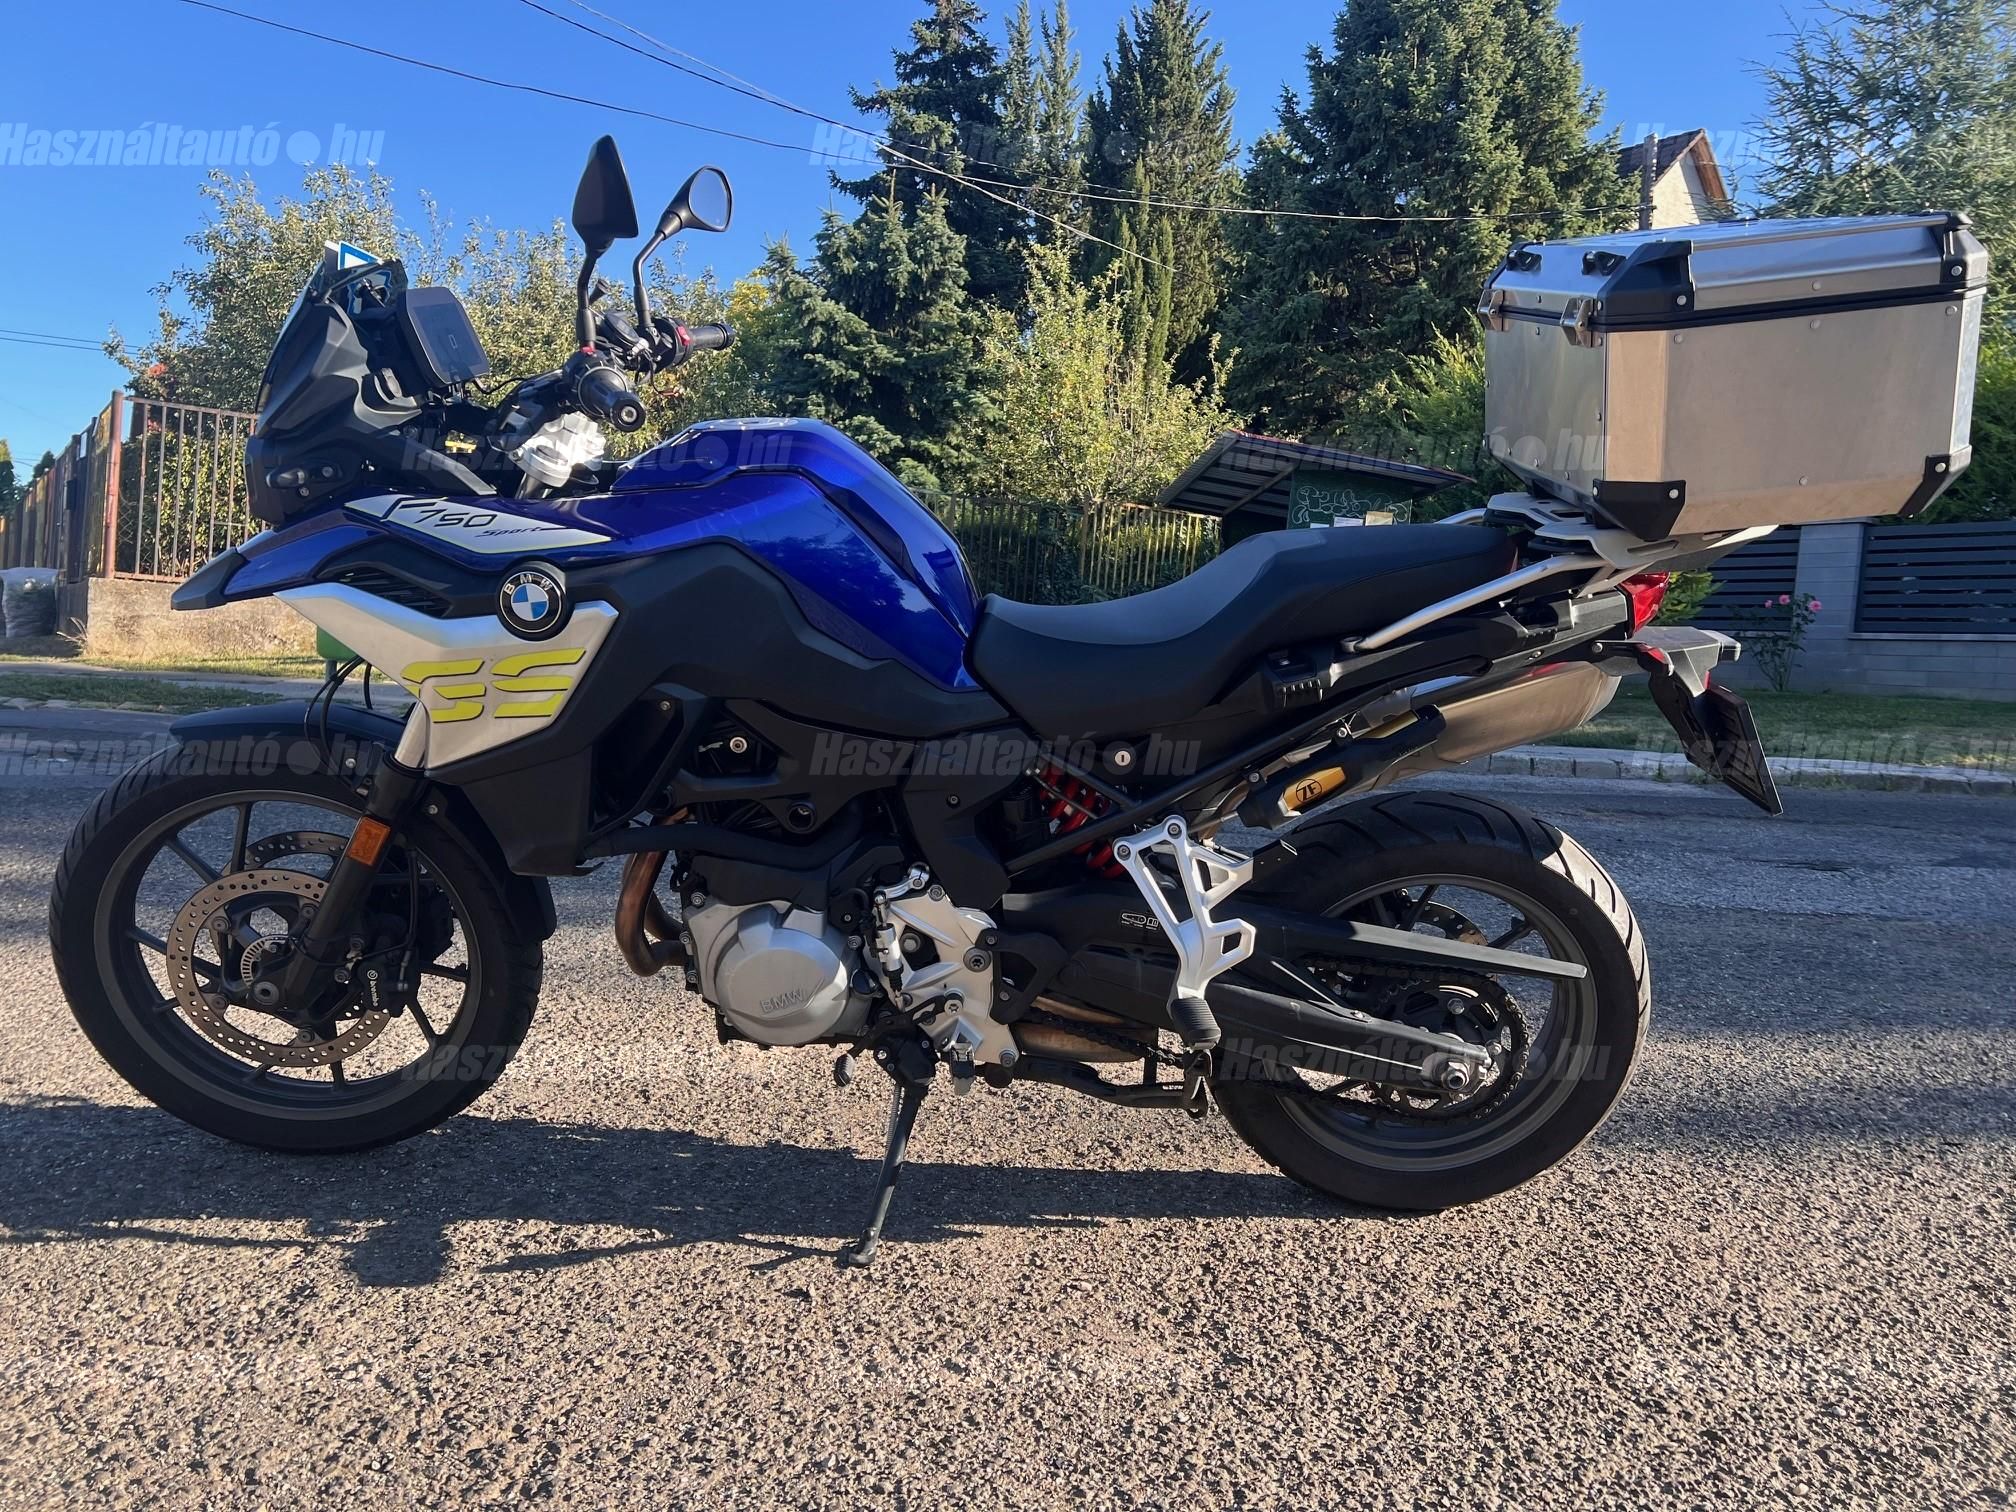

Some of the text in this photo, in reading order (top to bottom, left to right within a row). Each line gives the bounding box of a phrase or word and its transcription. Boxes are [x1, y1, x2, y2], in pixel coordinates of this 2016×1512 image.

[415, 509, 498, 528] 750
[475, 526, 567, 538] Sport
[502, 572, 554, 596] BMW
[760, 985, 807, 1013] BMW
